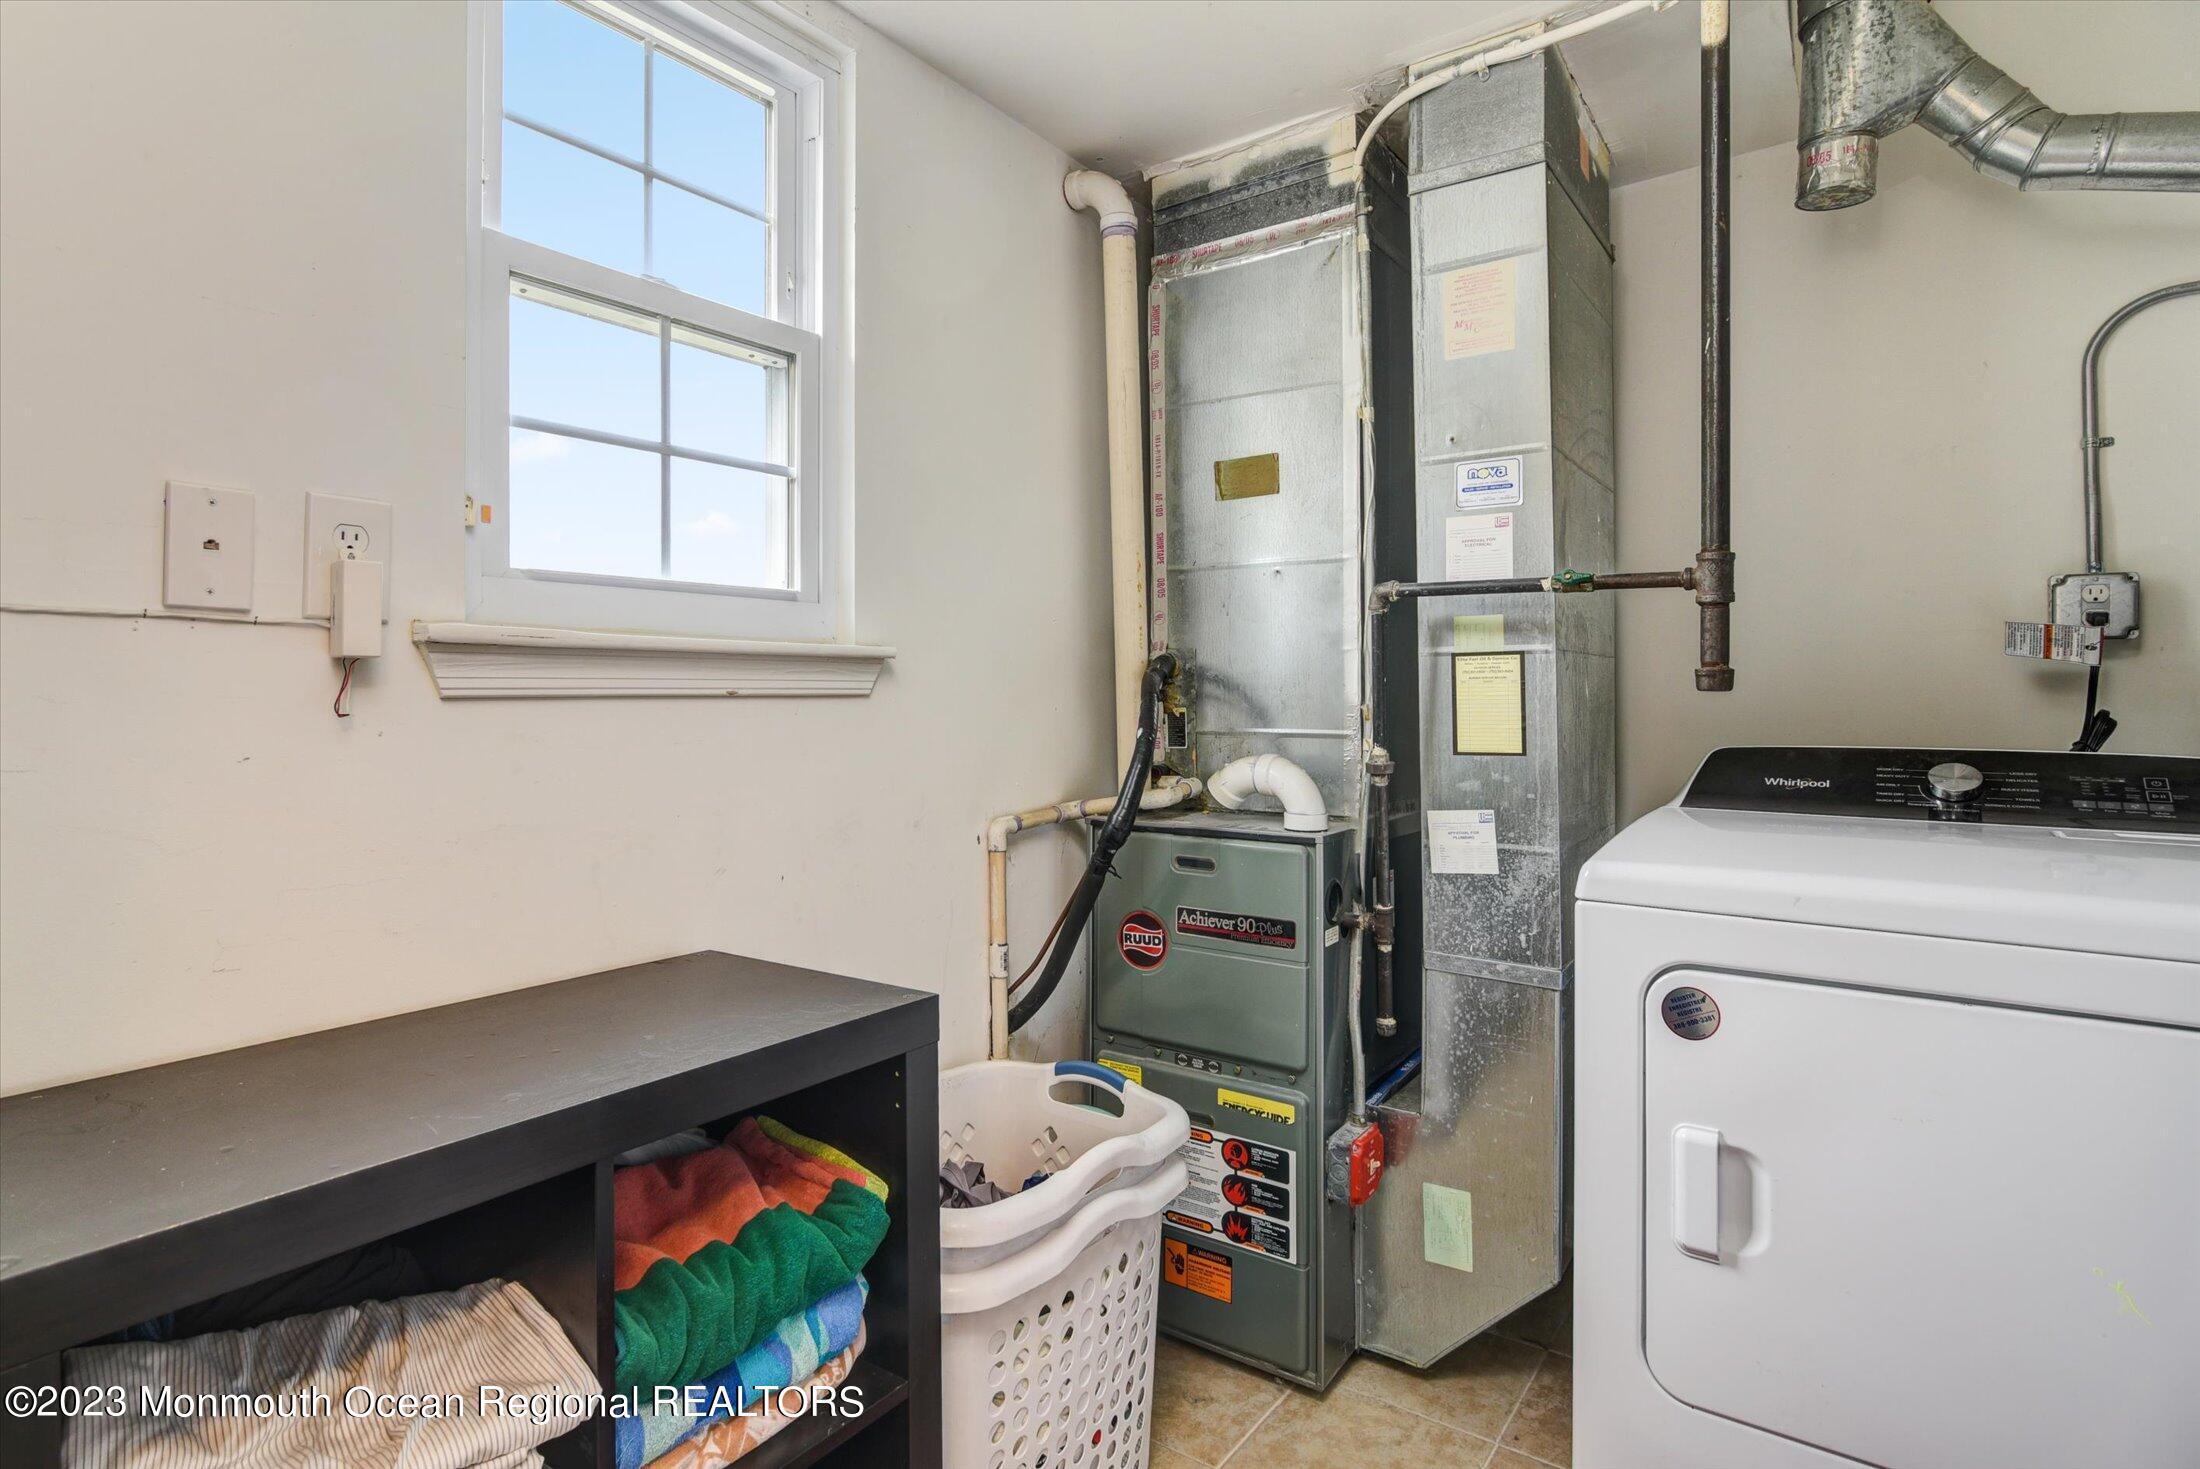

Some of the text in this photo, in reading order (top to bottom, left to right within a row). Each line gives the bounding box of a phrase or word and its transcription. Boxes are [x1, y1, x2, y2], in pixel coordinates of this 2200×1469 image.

[1192, 244, 1222, 259] SHURTAPE
[1151, 304, 1161, 337] SHURTAPE
[1467, 465, 1508, 480] nova
[1155, 493, 1164, 517] AF-100
[1156, 532, 1165, 565] SHURTAPE
[1157, 577, 1166, 599] 08/05
[1764, 777, 1830, 789] Whirlpool
[1179, 909, 1235, 931] Achiever
[1237, 917, 1255, 933] 90
[1124, 932, 1162, 946] RUUD
[1670, 992, 1696, 1003] REGISTER
[1178, 1216, 1205, 1229] WARNING
[1196, 1249, 1227, 1264] WARNING
